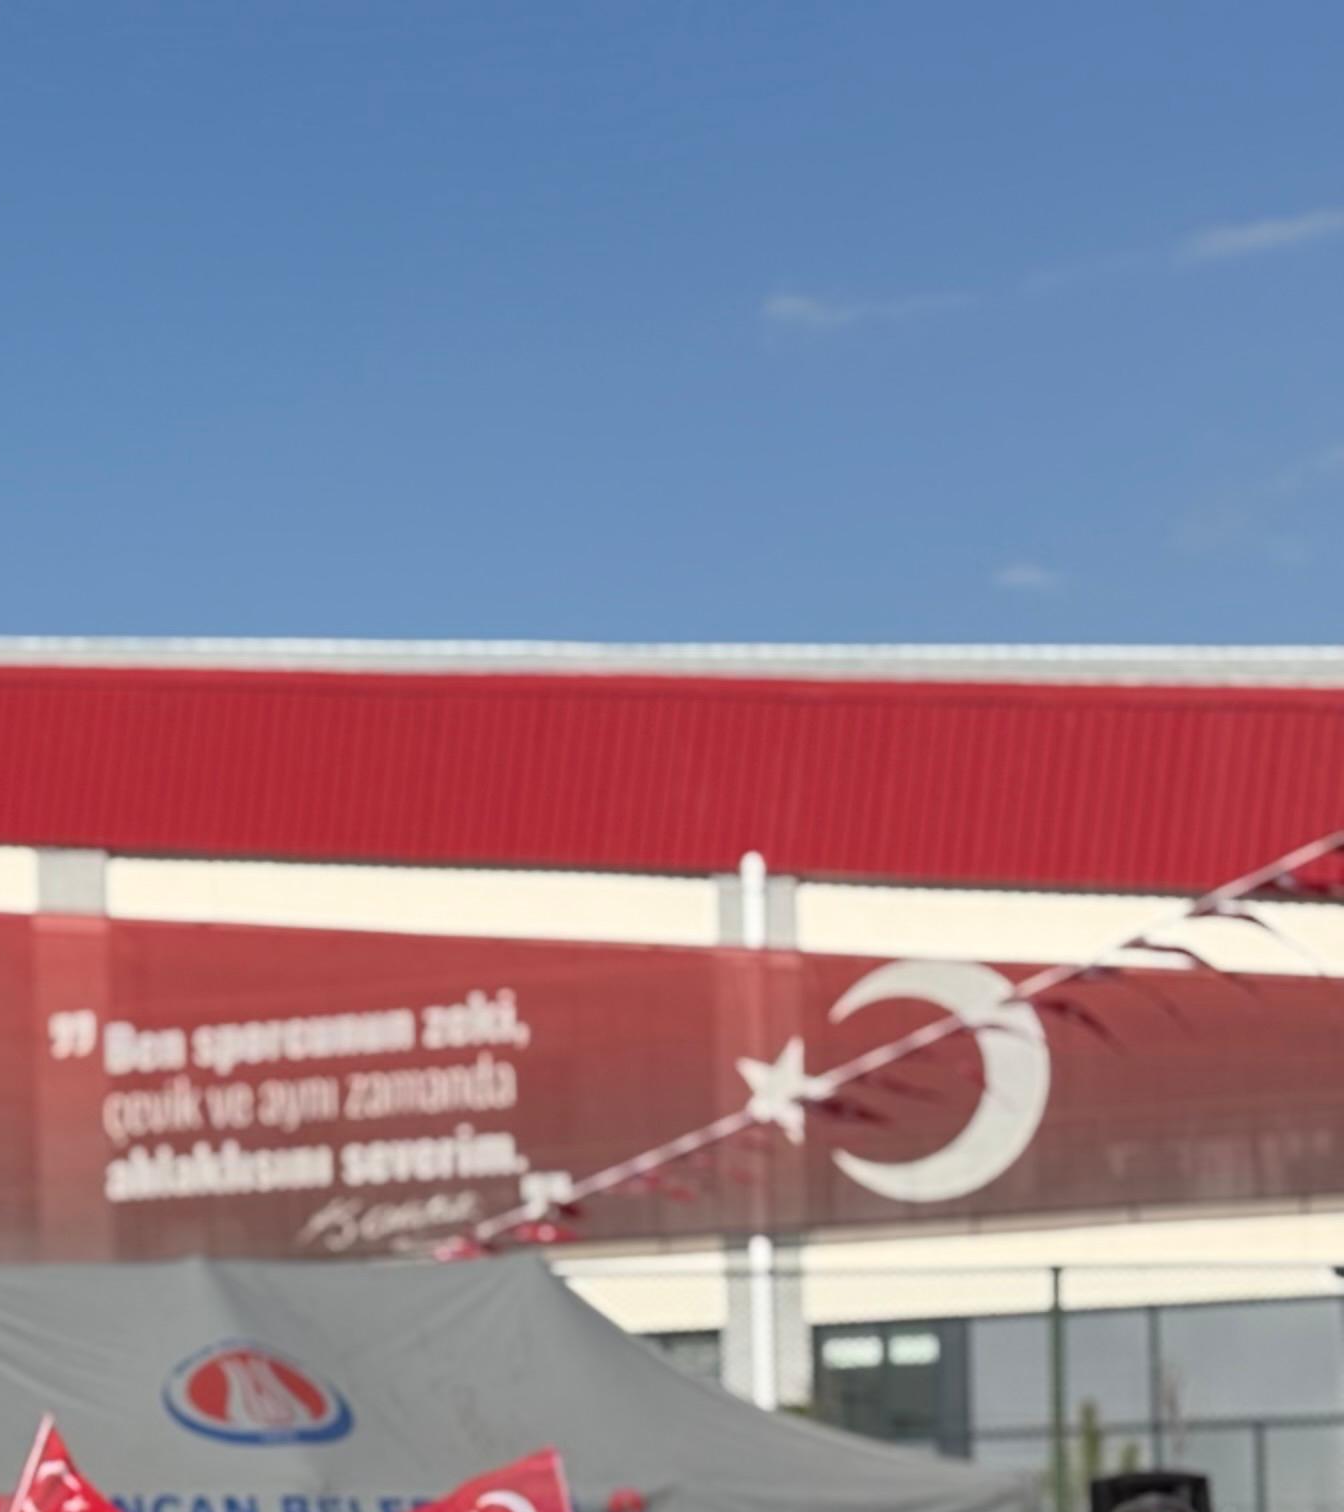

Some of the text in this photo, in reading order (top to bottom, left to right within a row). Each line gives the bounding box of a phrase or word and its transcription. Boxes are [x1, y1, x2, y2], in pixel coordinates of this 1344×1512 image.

[104, 1020, 186, 1075] Ben
[210, 1081, 254, 1129] ve
[344, 1052, 516, 1121] zamanda
